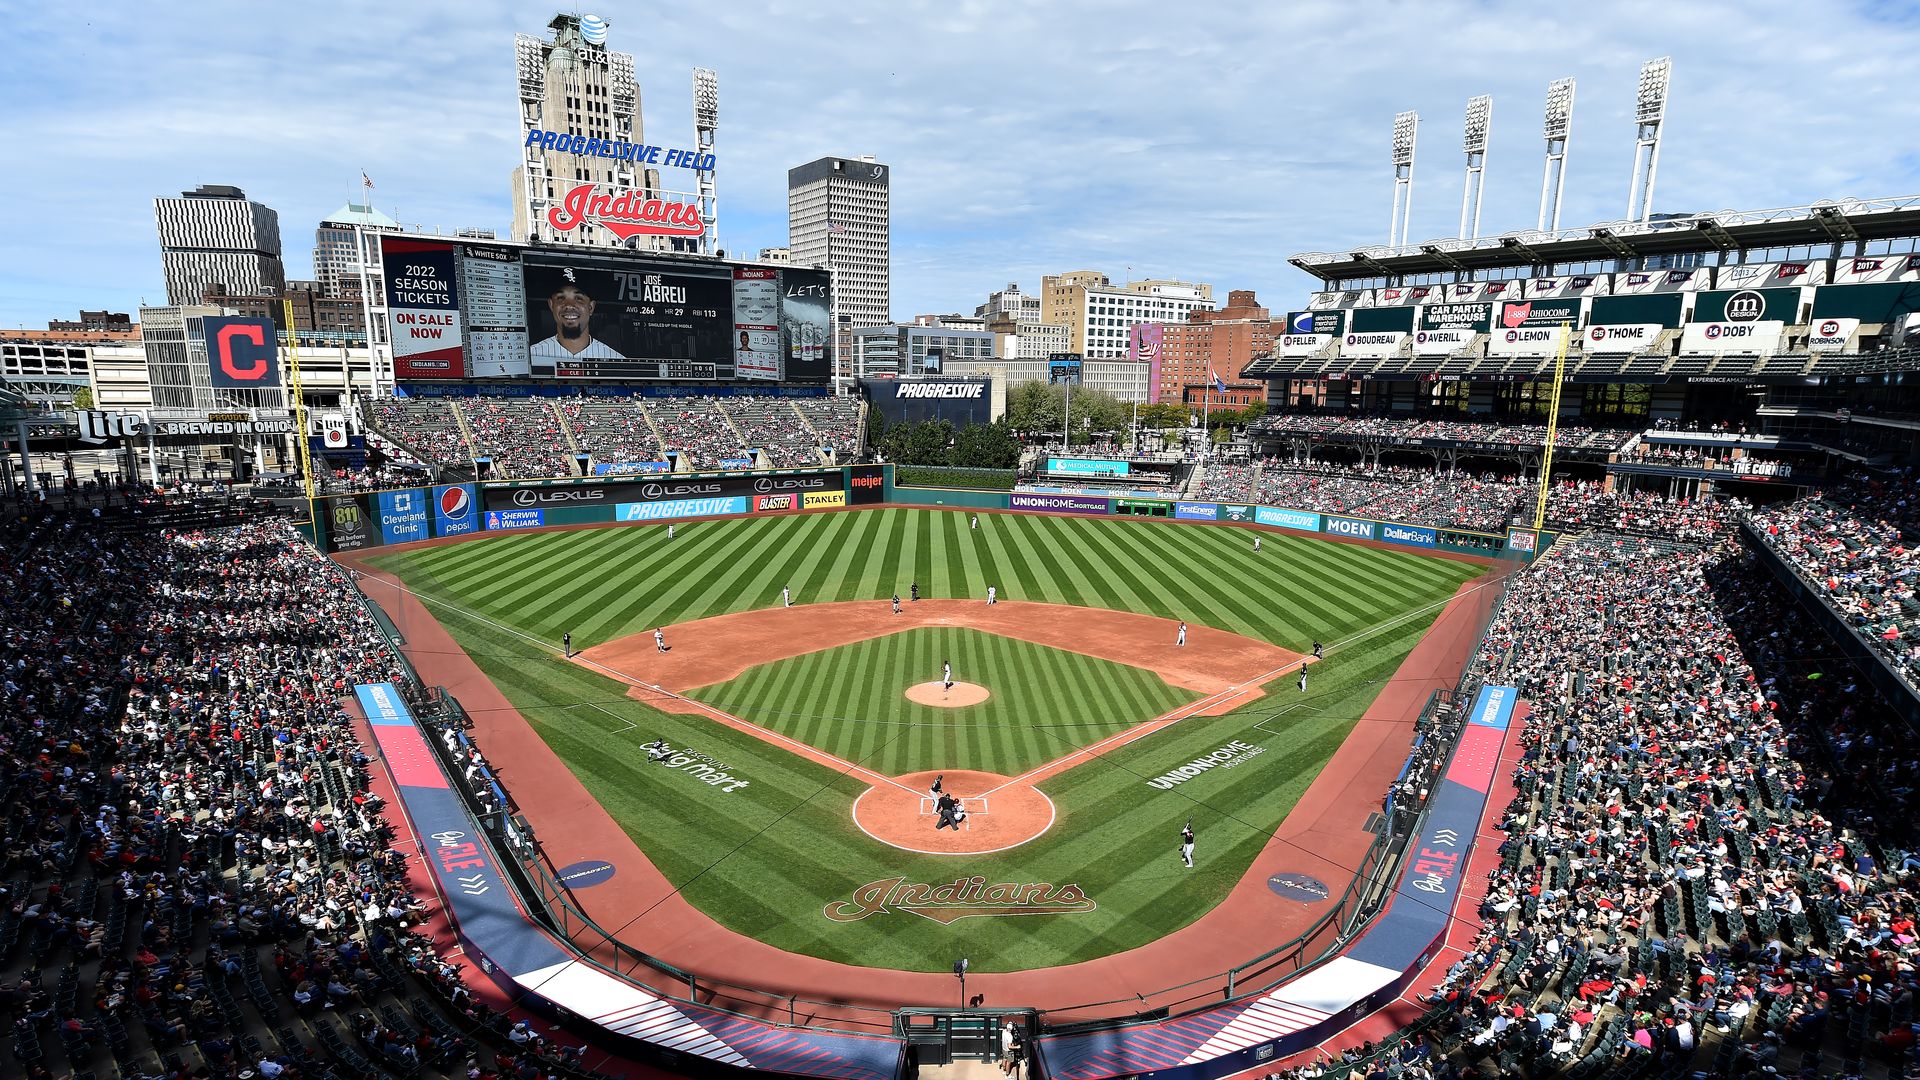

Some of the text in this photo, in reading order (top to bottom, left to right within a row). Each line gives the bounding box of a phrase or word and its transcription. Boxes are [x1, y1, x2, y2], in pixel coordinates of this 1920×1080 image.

[579, 44, 608, 64] at&
[525, 129, 716, 171] PROGRESSIVE FIELD
[870, 166, 883, 179] 9
[548, 184, 705, 241] Indians
[474, 250, 495, 258] WHITE
[405, 265, 436, 277] 2022
[1856, 261, 1874, 270] 2017
[1734, 269, 1749, 277] 2013
[395, 278, 447, 291] SEASON
[614, 273, 662, 300] 79 JOSÉ
[644, 285, 686, 303] ABREU
[786, 284, 826, 298] LET'S
[395, 292, 450, 304] TICKETS
[640, 306, 655, 314] .266
[1431, 304, 1484, 314] CAR PARTS
[1730, 298, 1758, 312] m
[396, 313, 453, 326] ON SALE
[1428, 313, 1486, 322] WAREHOUSE
[1530, 309, 1570, 318] OHIOCOMP
[410, 328, 442, 339] NOW
[1608, 327, 1644, 338] THOME
[1707, 326, 1754, 337] 14 DOBY
[1822, 324, 1836, 333] 20
[1292, 337, 1316, 345] FELLER
[1357, 335, 1395, 344] BOUDREAU
[1428, 332, 1460, 342] AVERILL
[1519, 331, 1550, 340] LEMON
[217, 324, 268, 380] C
[413, 385, 464, 394] DollarBank
[478, 385, 526, 394] DollarBank
[656, 386, 695, 394] DollarBank
[896, 384, 985, 398] PROGRESSIVE
[209, 414, 249, 422] PROUDLY
[324, 418, 344, 430] Lite
[75, 410, 141, 444] Lite
[168, 422, 288, 435] BREWED IN OHIO
[1733, 463, 1792, 477] THE CORNER
[774, 479, 824, 488] LEXUS
[852, 476, 882, 488] meijer
[665, 484, 721, 494] LEXUS
[539, 490, 604, 502] LEXUS
[805, 495, 844, 504] STANLEY
[627, 498, 735, 519] PROGRESSIVE
[1178, 506, 1216, 516] FirstEnergy
[336, 507, 358, 524] 811
[383, 512, 426, 525] Cleveland
[502, 512, 538, 520] SHERWIN
[1258, 511, 1315, 527] PROGRESSIVE
[393, 523, 418, 534] Clinic
[446, 521, 470, 533] pepsi
[502, 519, 540, 528] WILLIAMS.
[1327, 518, 1371, 537] MOEN
[346, 534, 365, 542] before
[1384, 528, 1433, 544] DollarBank
[1512, 532, 1530, 543] drug
[683, 746, 734, 771] DISCOUNT
[824, 876, 1096, 925] Indians
